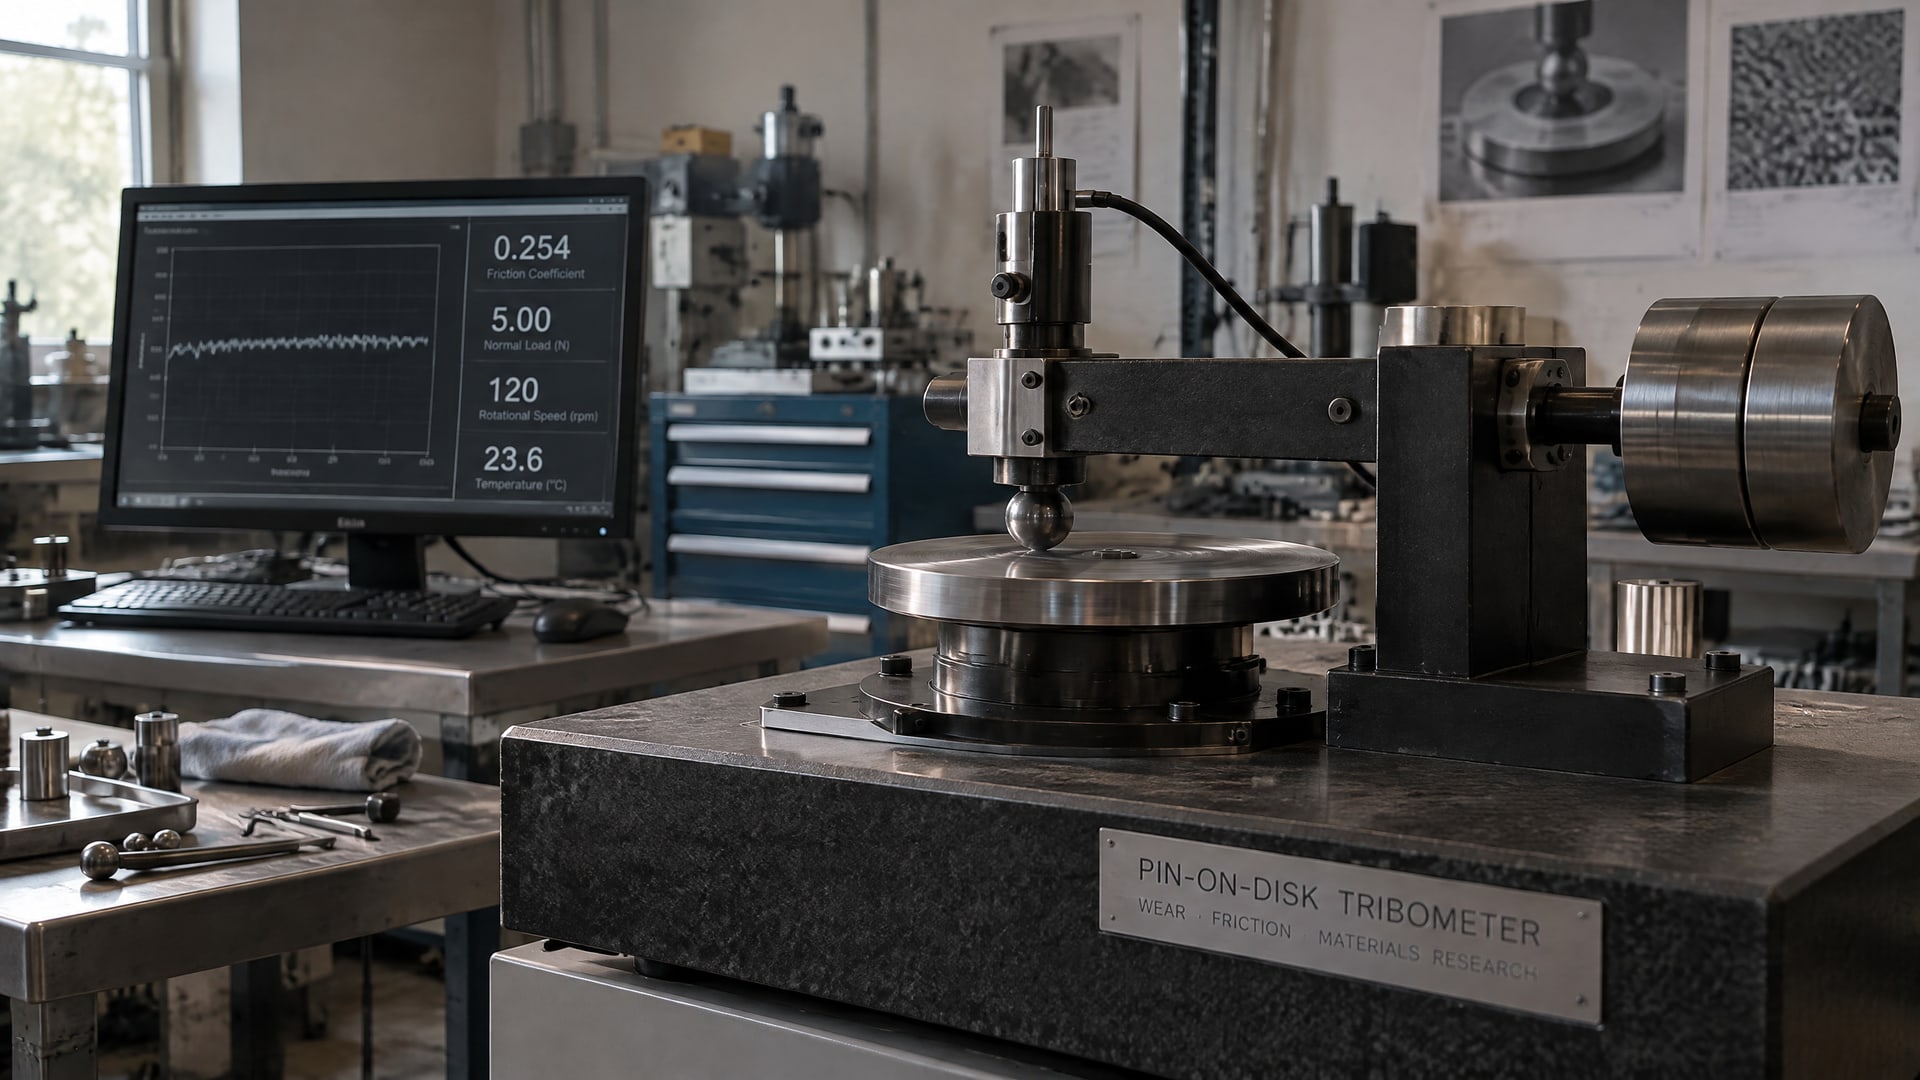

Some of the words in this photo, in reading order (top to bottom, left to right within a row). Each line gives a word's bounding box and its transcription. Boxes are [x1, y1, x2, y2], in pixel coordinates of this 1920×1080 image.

[494, 234, 571, 260] 0.254
[487, 268, 526, 280] Friction
[528, 268, 585, 280] Coefficient
[491, 306, 551, 332] 5.00
[484, 340, 522, 351] Normal
[525, 340, 551, 351] Load
[554, 340, 570, 352] (N)
[489, 376, 539, 403] 120
[479, 410, 531, 422] Rotational
[533, 410, 567, 424] Speed
[570, 410, 599, 424] (rpm)
[483, 446, 543, 473] 23.6
[475, 478, 543, 492] Temperature
[1138, 857, 1319, 911] PIN-ON-DISK
[1338, 889, 1541, 946] TRIBOMETER
[1138, 897, 1186, 921] WEAR
[1212, 911, 1292, 940] FRICTION
[1319, 930, 1420, 962] MATERIALS
[1432, 949, 1538, 983] RESEARCH
